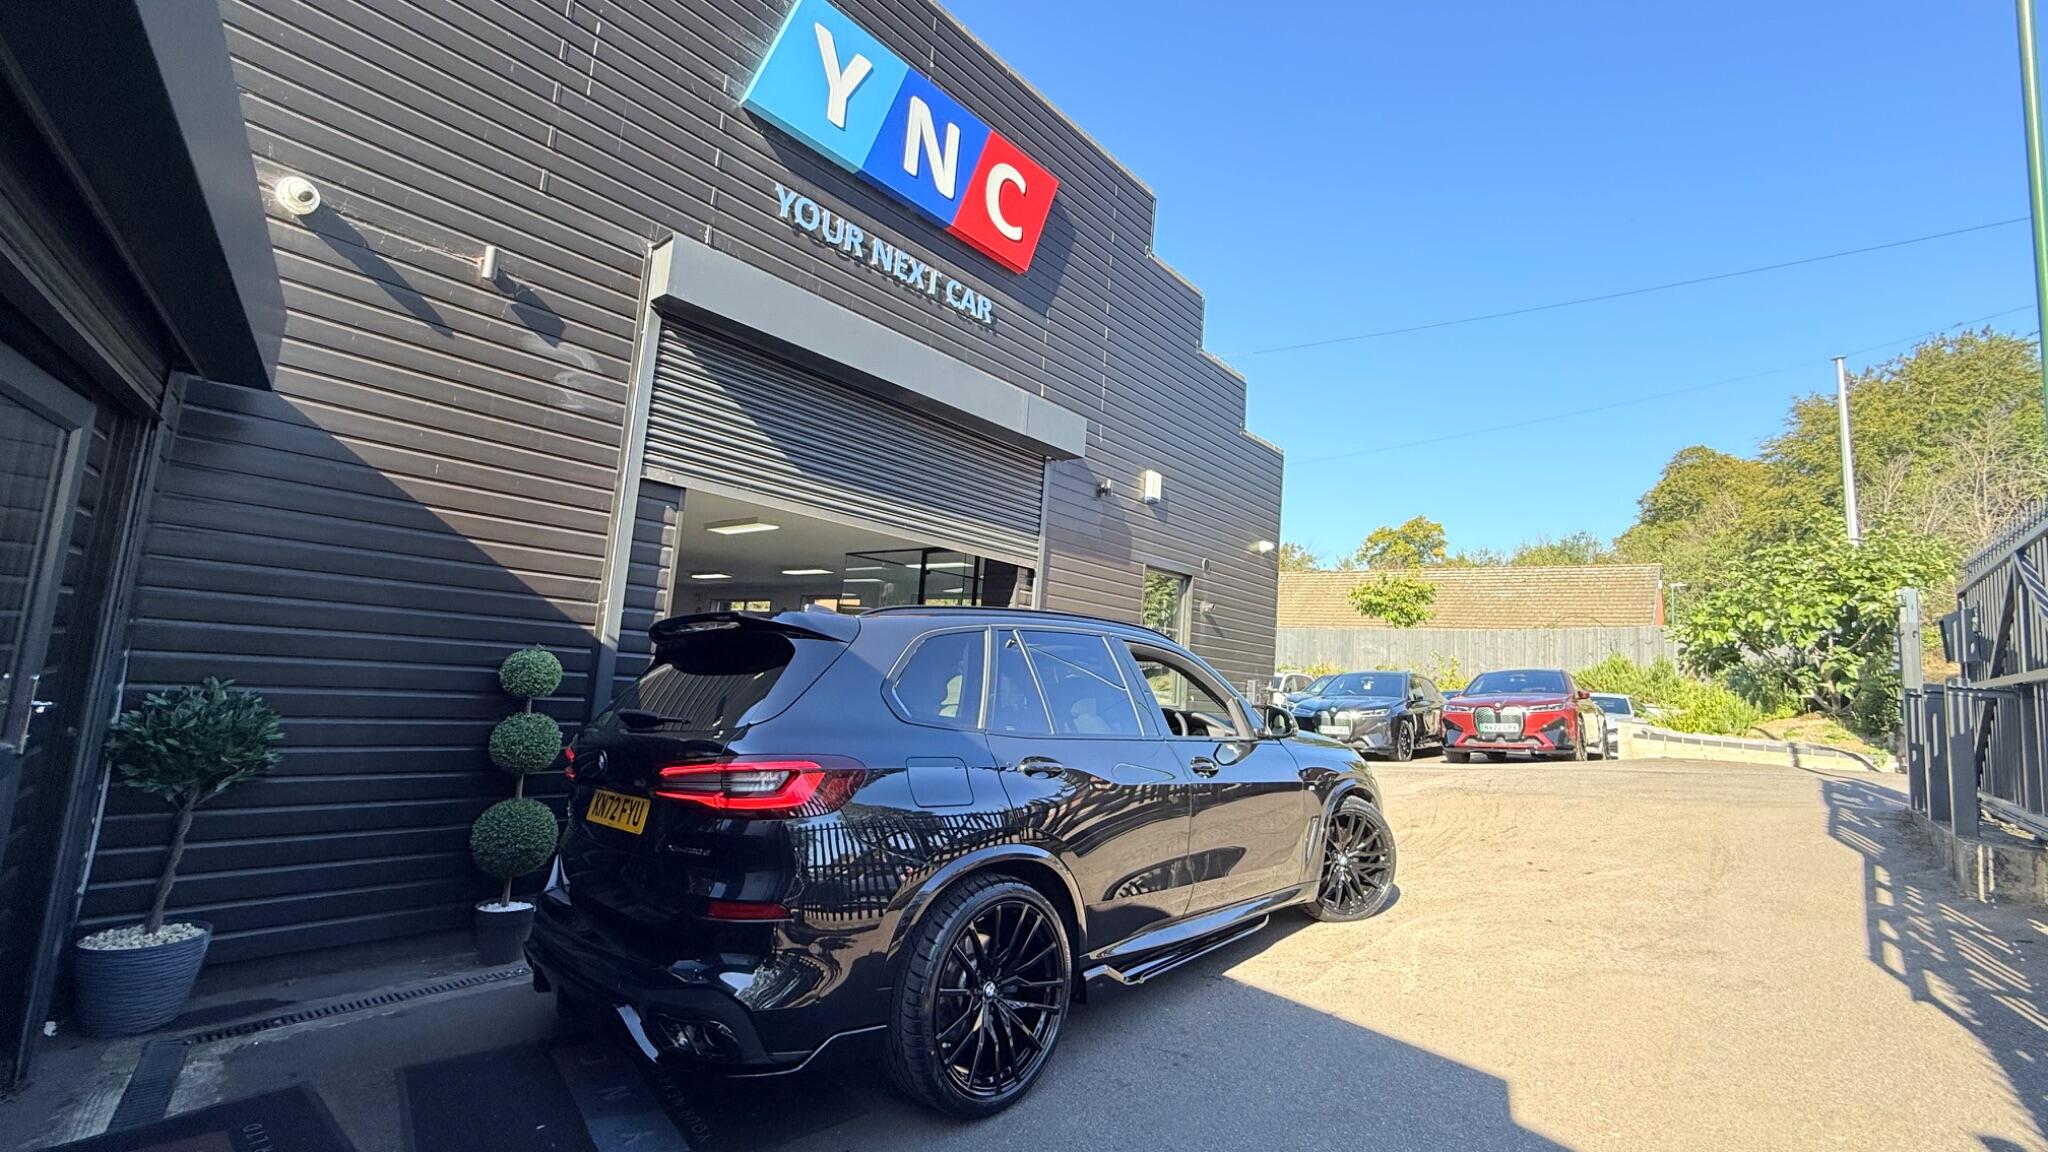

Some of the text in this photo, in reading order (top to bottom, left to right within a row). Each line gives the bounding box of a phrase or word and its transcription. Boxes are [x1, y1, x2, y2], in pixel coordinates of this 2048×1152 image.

[814, 22, 1027, 242] YNC
[775, 183, 993, 324] YOUR NEXT CAR
[592, 792, 644, 826] KN72 FYU
